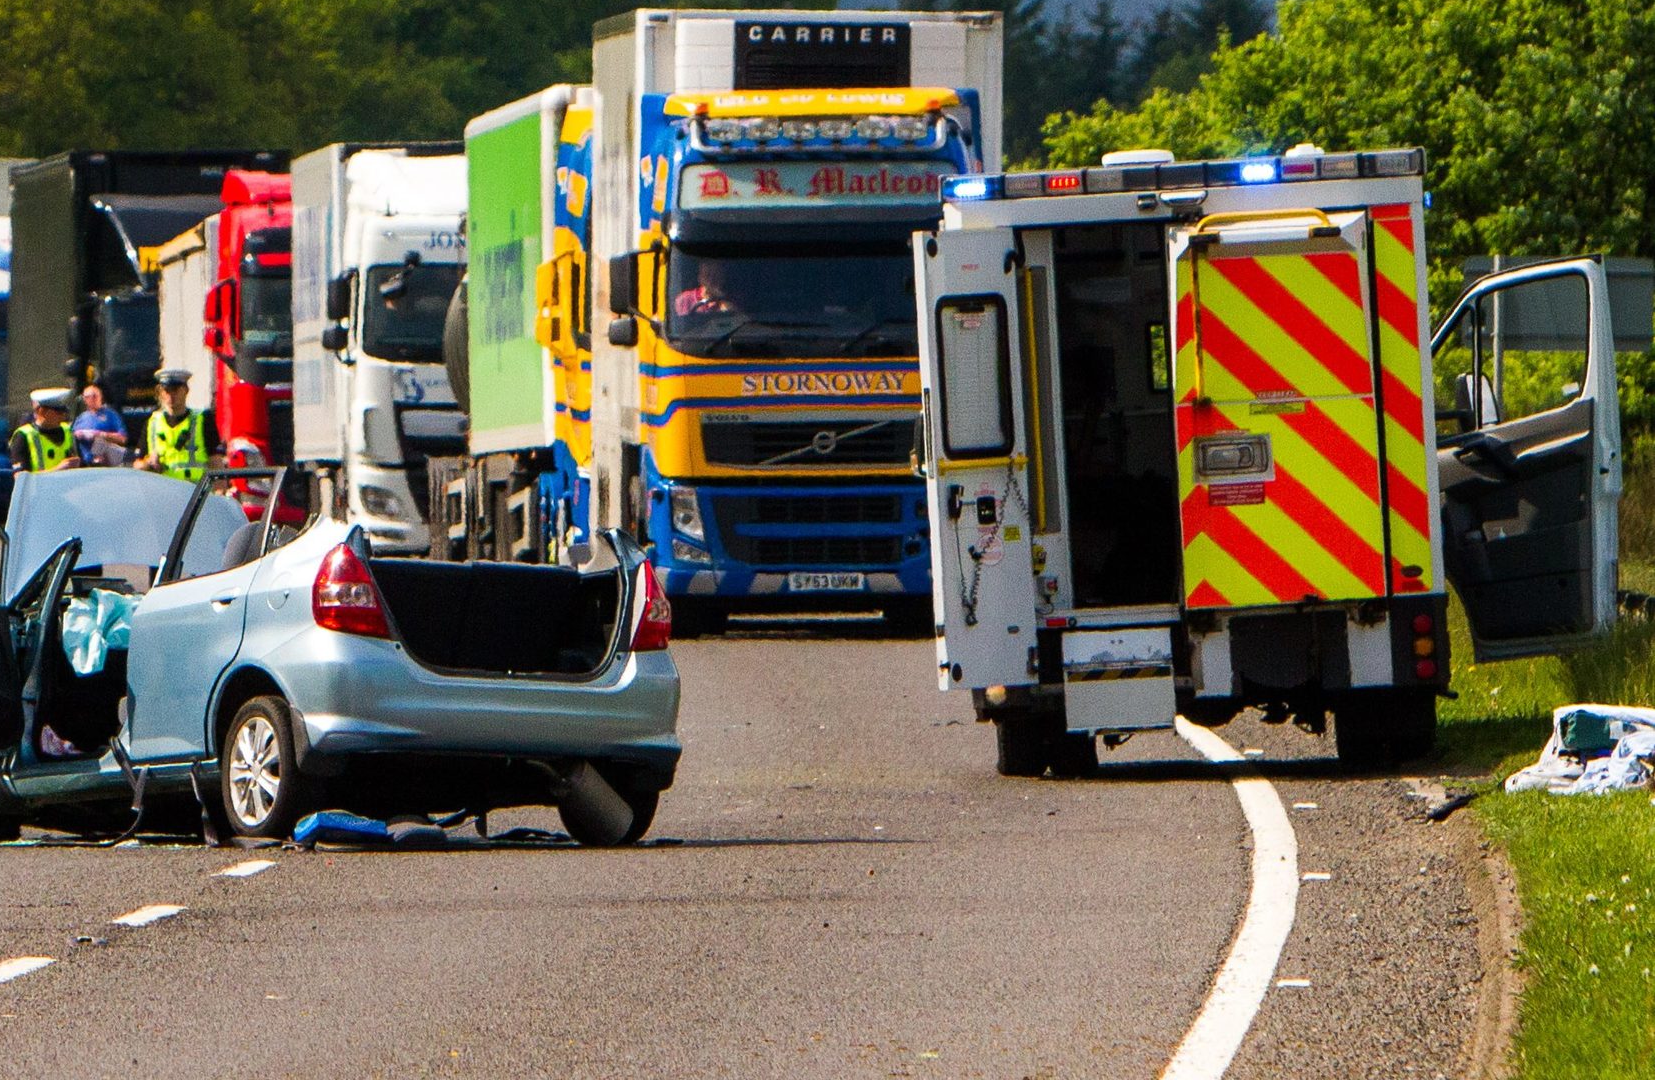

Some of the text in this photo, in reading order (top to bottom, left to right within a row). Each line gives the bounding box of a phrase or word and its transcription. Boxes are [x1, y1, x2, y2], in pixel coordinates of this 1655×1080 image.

[748, 25, 898, 43] CARRIER
[699, 168, 739, 198] D.
[754, 167, 795, 195] R.
[742, 372, 906, 394] STORNOWAY
